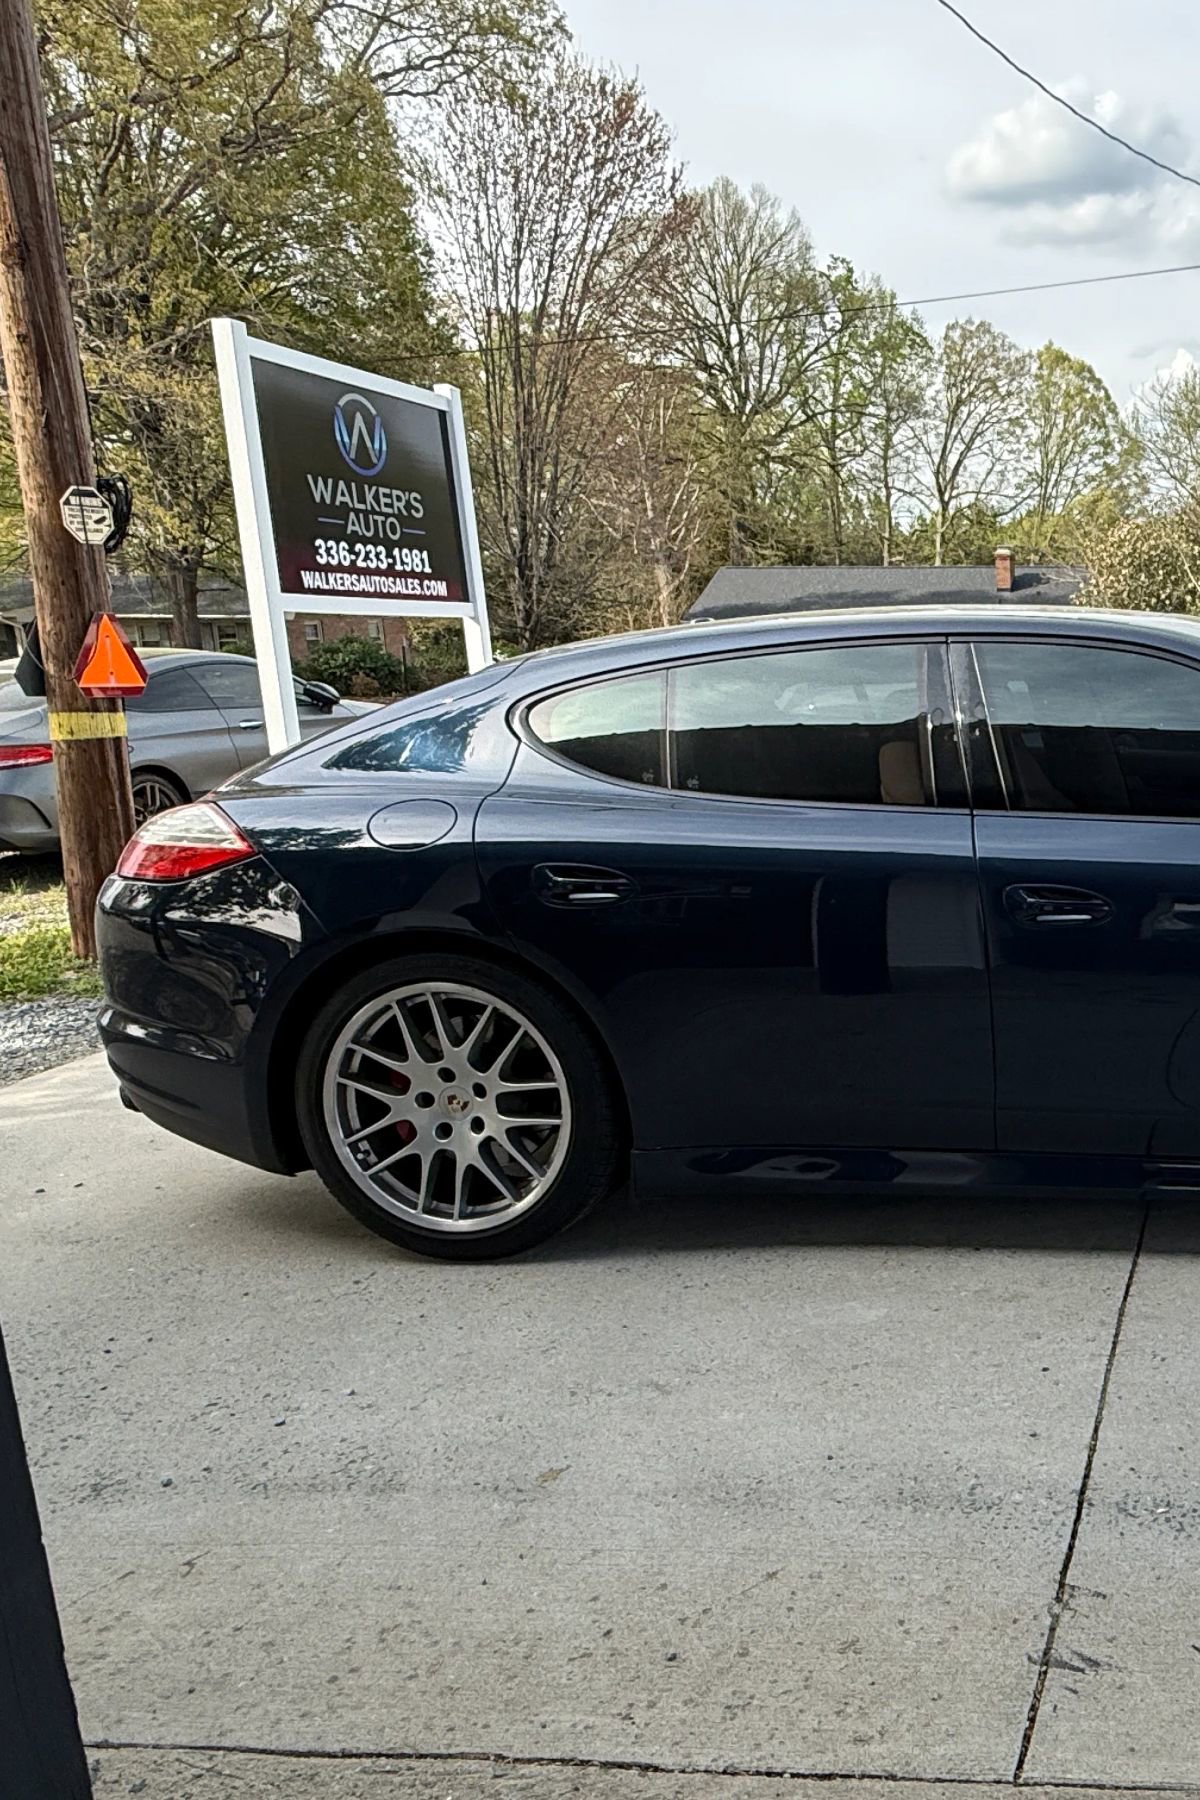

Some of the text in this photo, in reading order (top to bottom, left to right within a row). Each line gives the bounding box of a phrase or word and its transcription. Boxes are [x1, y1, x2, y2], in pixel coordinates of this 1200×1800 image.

[306, 473, 424, 518] WALKER'S
[346, 511, 402, 541] AUTO
[314, 538, 433, 573] 336-233-1981
[301, 570, 448, 597] WALKERSAUTOSALES.COM
